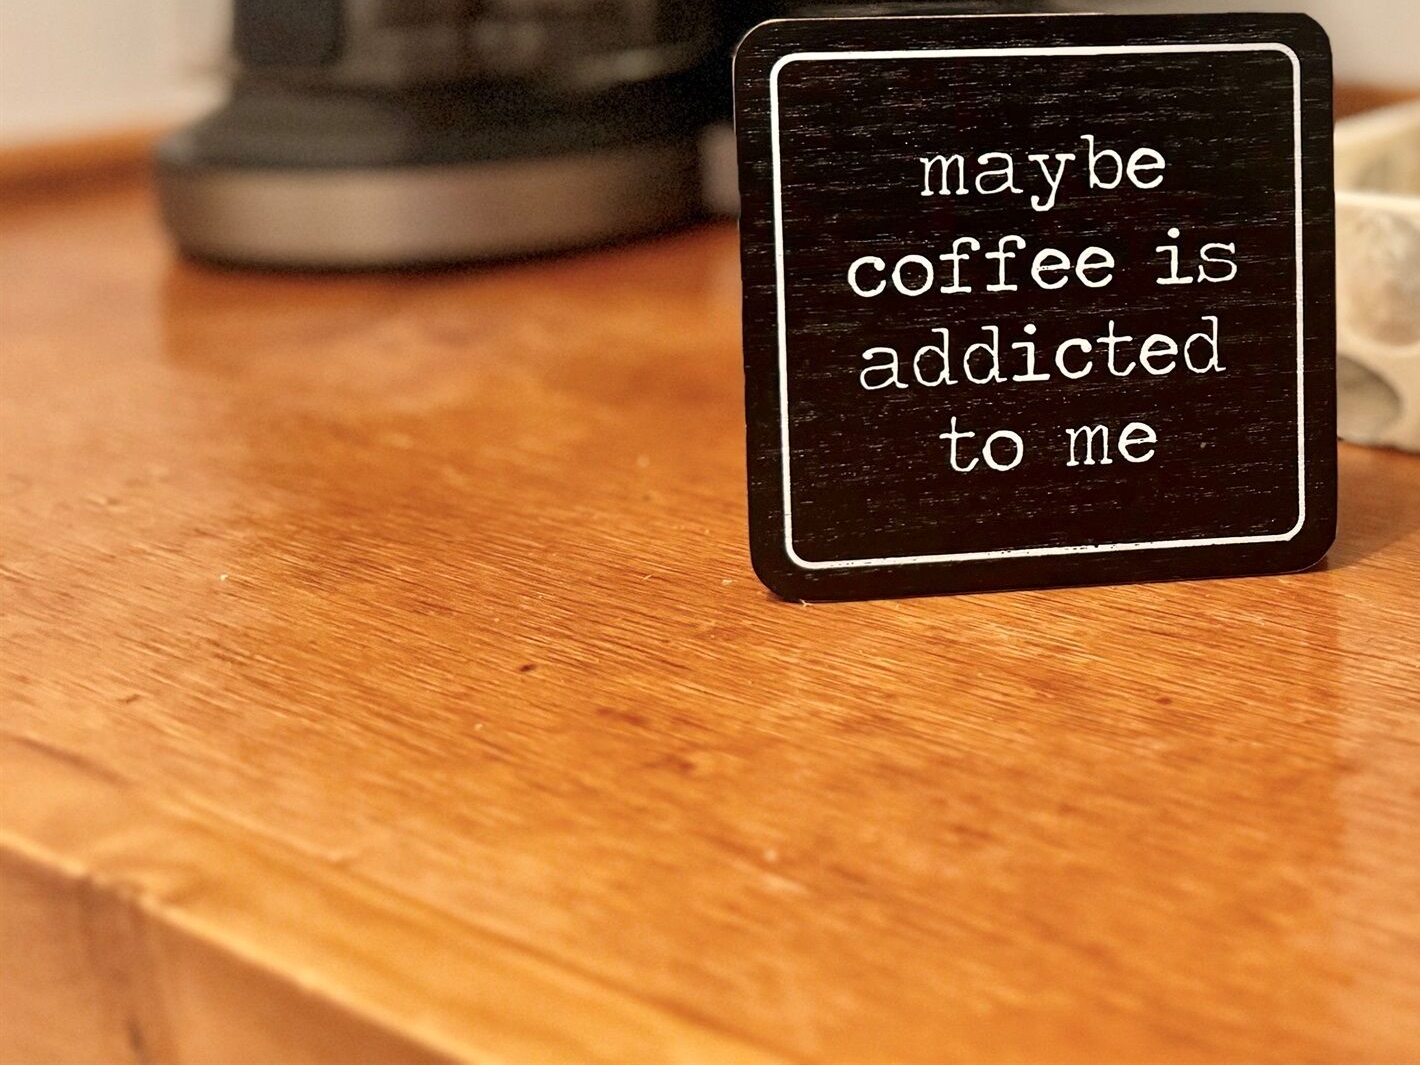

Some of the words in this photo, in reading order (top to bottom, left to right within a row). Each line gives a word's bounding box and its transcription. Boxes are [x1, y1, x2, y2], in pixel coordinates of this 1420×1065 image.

[919, 134, 1167, 212] maybe
[846, 235, 1116, 298] coffee
[1155, 227, 1239, 286] is
[858, 315, 1227, 391] addicted
[939, 416, 1025, 473] to
[1065, 420, 1158, 467] me
